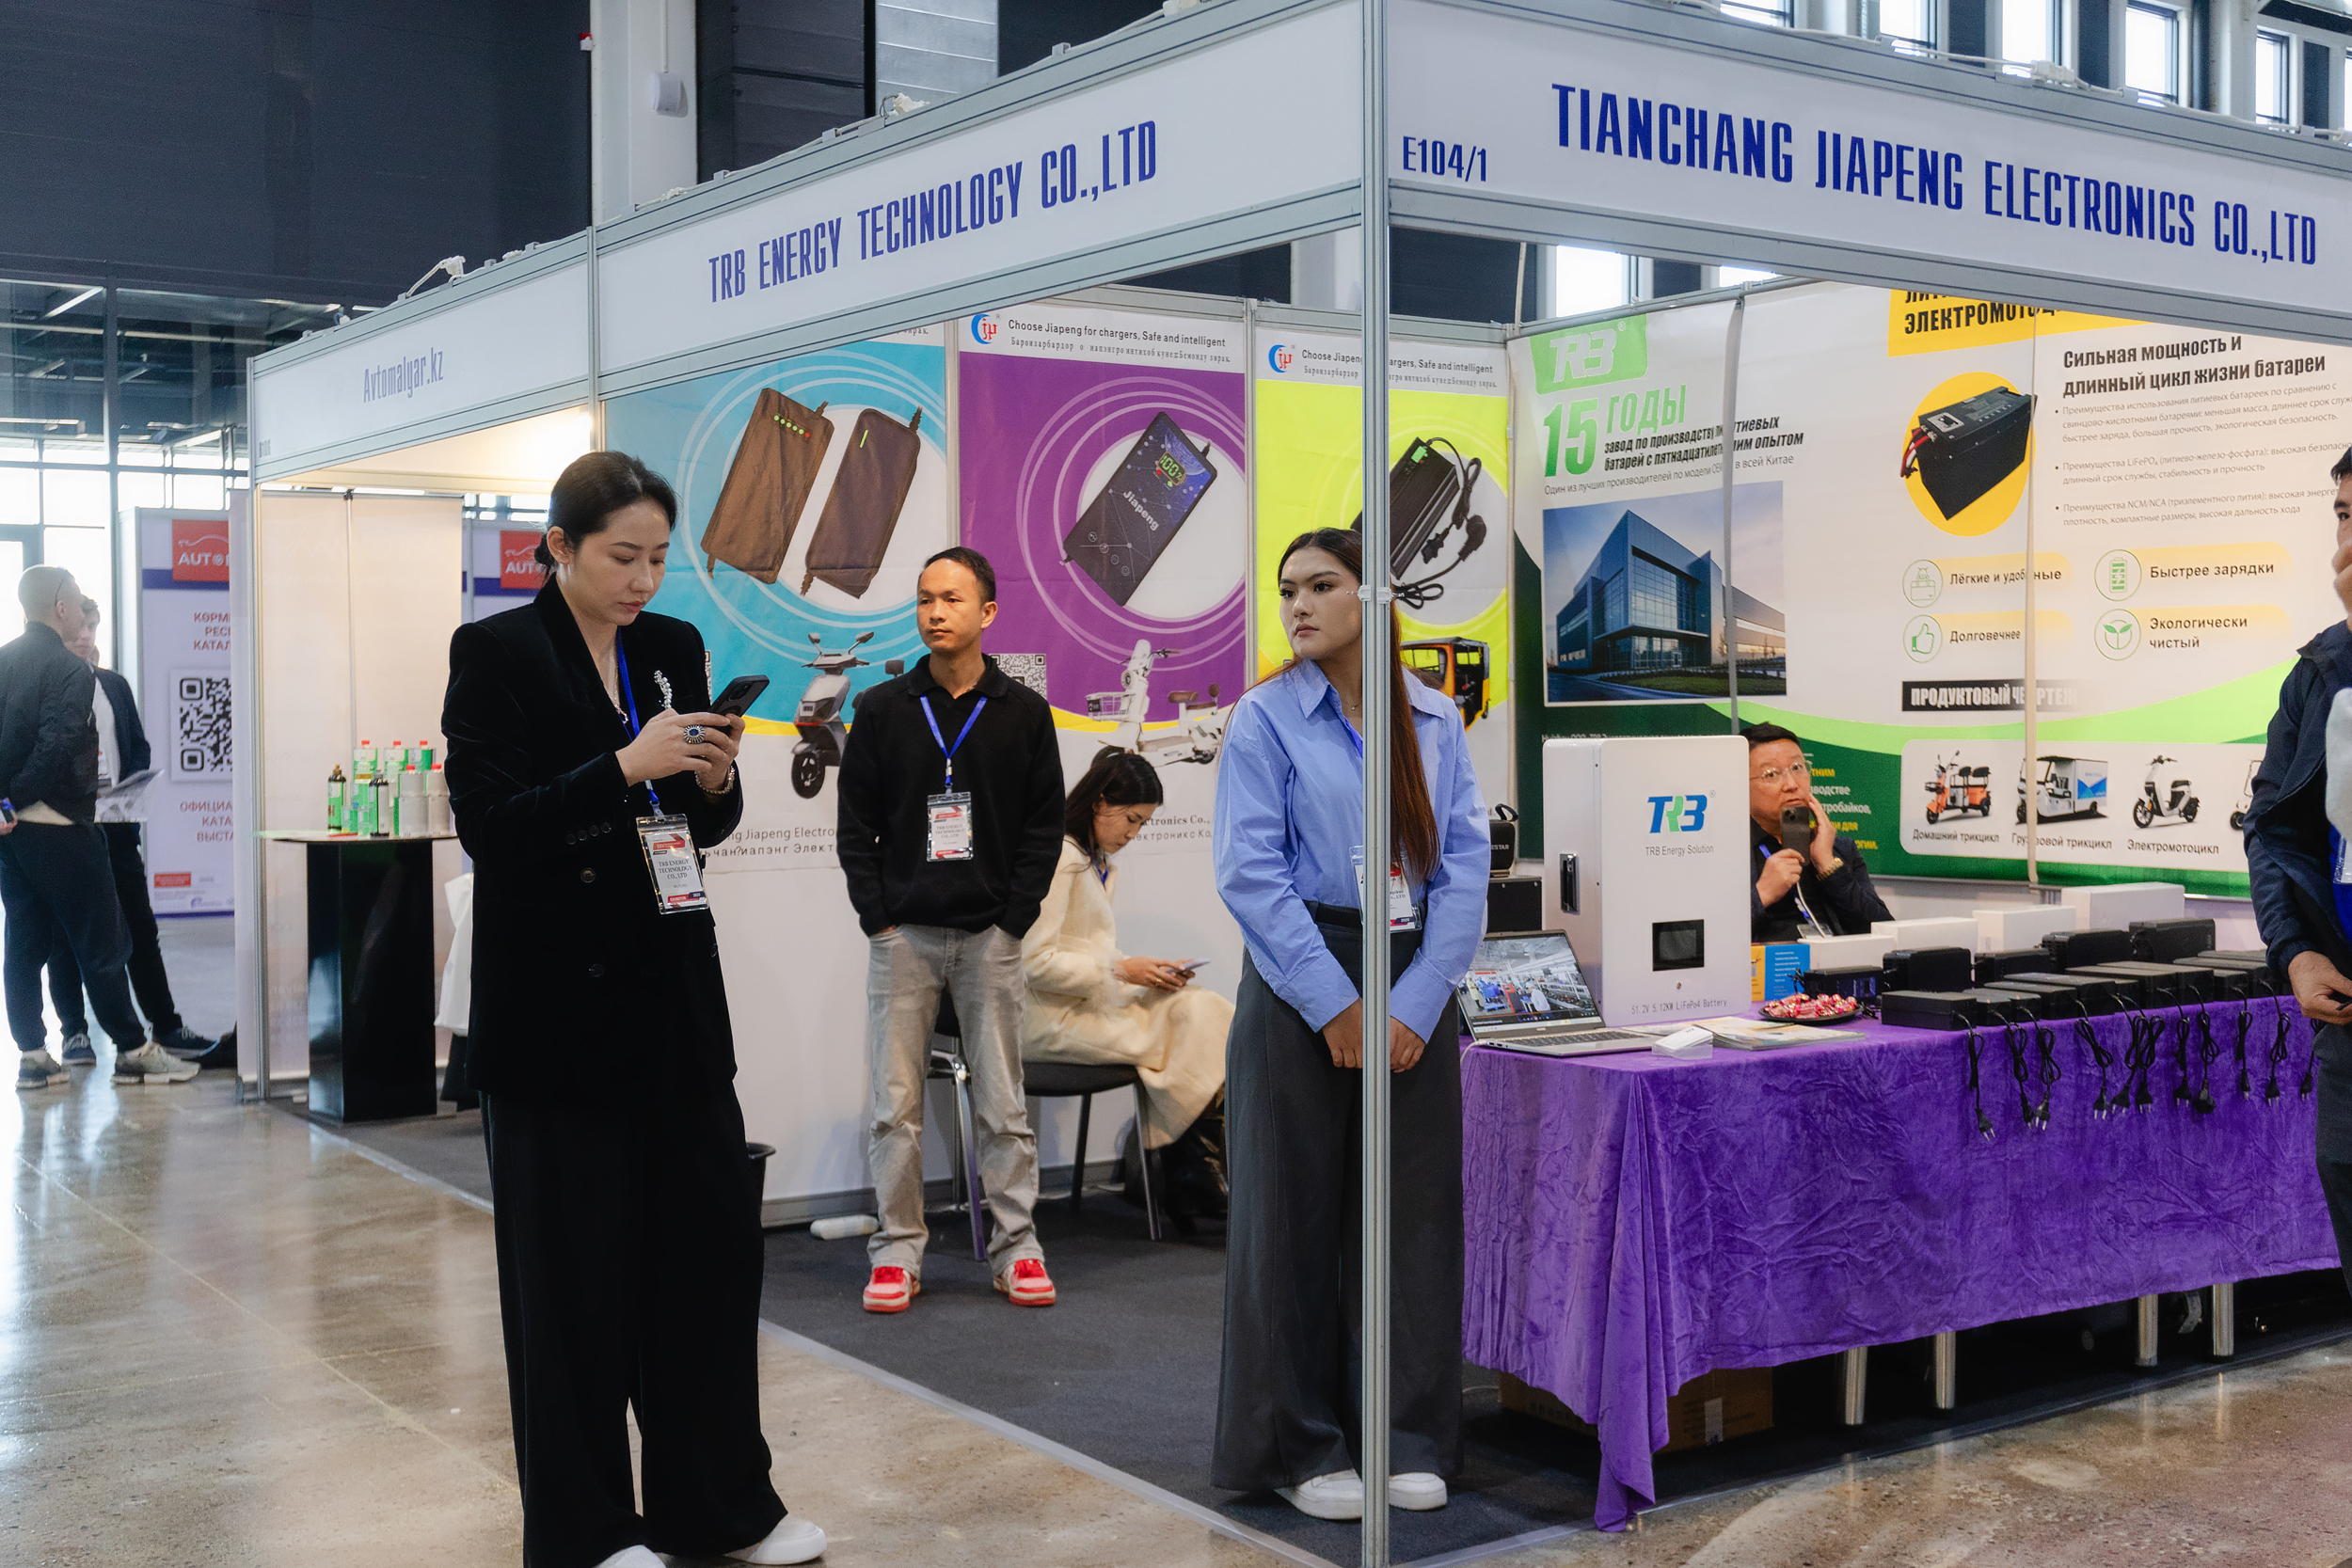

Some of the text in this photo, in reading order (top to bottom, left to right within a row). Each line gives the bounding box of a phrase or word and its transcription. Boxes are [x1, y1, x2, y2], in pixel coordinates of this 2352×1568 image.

[1402, 135, 1487, 182] E104/1
[1551, 83, 2316, 265] TIANCHANG JIAPENG ELECTRONICS CO.,LTD
[708, 119, 1156, 303] TRB ENERGY TECHNOLOGY CO.,LTD
[1009, 319, 1225, 348] Choose Jiapeng for chargers, Safe and intelligent
[1302, 350, 1332, 361] Choose
[1419, 359, 1436, 369] Safe
[1438, 361, 1453, 371] and
[1453, 361, 1493, 374] intelligent
[1549, 328, 1617, 384] TRB
[2064, 348, 2137, 369] Сильная
[2141, 339, 2227, 360] мощность
[363, 346, 444, 404] Avtomalyar.kz
[2062, 356, 2326, 399] длинный цикл жизни батареи
[2062, 404, 2125, 416] Преимущества
[2126, 397, 2189, 410] использования
[2190, 393, 2229, 404] литиевых
[2230, 390, 2269, 401] батареек
[2283, 383, 2331, 395] сравнению
[2062, 416, 2158, 429] свинцово-кислотными
[2203, 406, 2241, 417] меньшая
[2243, 404, 2269, 414] масса,
[2271, 401, 2308, 412] длиннее
[2309, 399, 2329, 408] срок
[1543, 382, 1686, 478] 15 ГОДЫ
[1605, 438, 1633, 453] завод
[1635, 436, 1648, 450] по
[1650, 426, 1715, 449] производству
[2062, 412, 2339, 443] быстрее заряда, большая прочность, экологическая безопасность.
[1605, 433, 1804, 471] батарей с опытом
[2062, 460, 2125, 471] Преимущества
[2271, 446, 2307, 455] высокая
[1544, 484, 1565, 496] Один
[1579, 482, 1605, 493] лучших
[1607, 470, 1672, 487] производителей
[1673, 470, 1683, 480] по
[1742, 455, 1764, 468] всей
[1766, 455, 1794, 467] Китае
[2062, 474, 2101, 485] длинный
[2102, 475, 2122, 483] срок
[2124, 472, 2156, 482] службы,
[2158, 467, 2211, 479] стабильность
[2220, 463, 2265, 474] прочность
[1123, 491, 1159, 531] Jiapeng
[2062, 502, 2126, 513] Преимущества
[2128, 499, 2166, 508] NCM/NCA
[2168, 493, 2235, 508] (триэлементного
[2237, 491, 2267, 501] лития):
[2269, 491, 2305, 500] высокая
[2064, 505, 2301, 527] плотность, компактные размеры, высокая дальность хода
[1949, 573, 1991, 585] Лёгкие
[2151, 564, 2274, 579] Быстрее зарядки
[1949, 630, 2021, 643] Долговечнее
[2150, 617, 2248, 630] Экологически
[2149, 636, 2200, 649] чистый
[1911, 683, 2011, 709] ПРОДУКТОВЫЙ
[1647, 795, 1708, 833] TRB
[745, 829, 791, 842] Jiapeng
[794, 827, 835, 838] Electro
[1912, 829, 2000, 845] Домашний трикцикл
[2067, 836, 2112, 850] трикцикл
[2127, 839, 2219, 855] Электромотоцикл
[1645, 844, 1714, 858] TRB Energy Solution
[659, 865, 692, 874] TECHNOLOGY
[1703, 999, 1727, 1008] Battery
